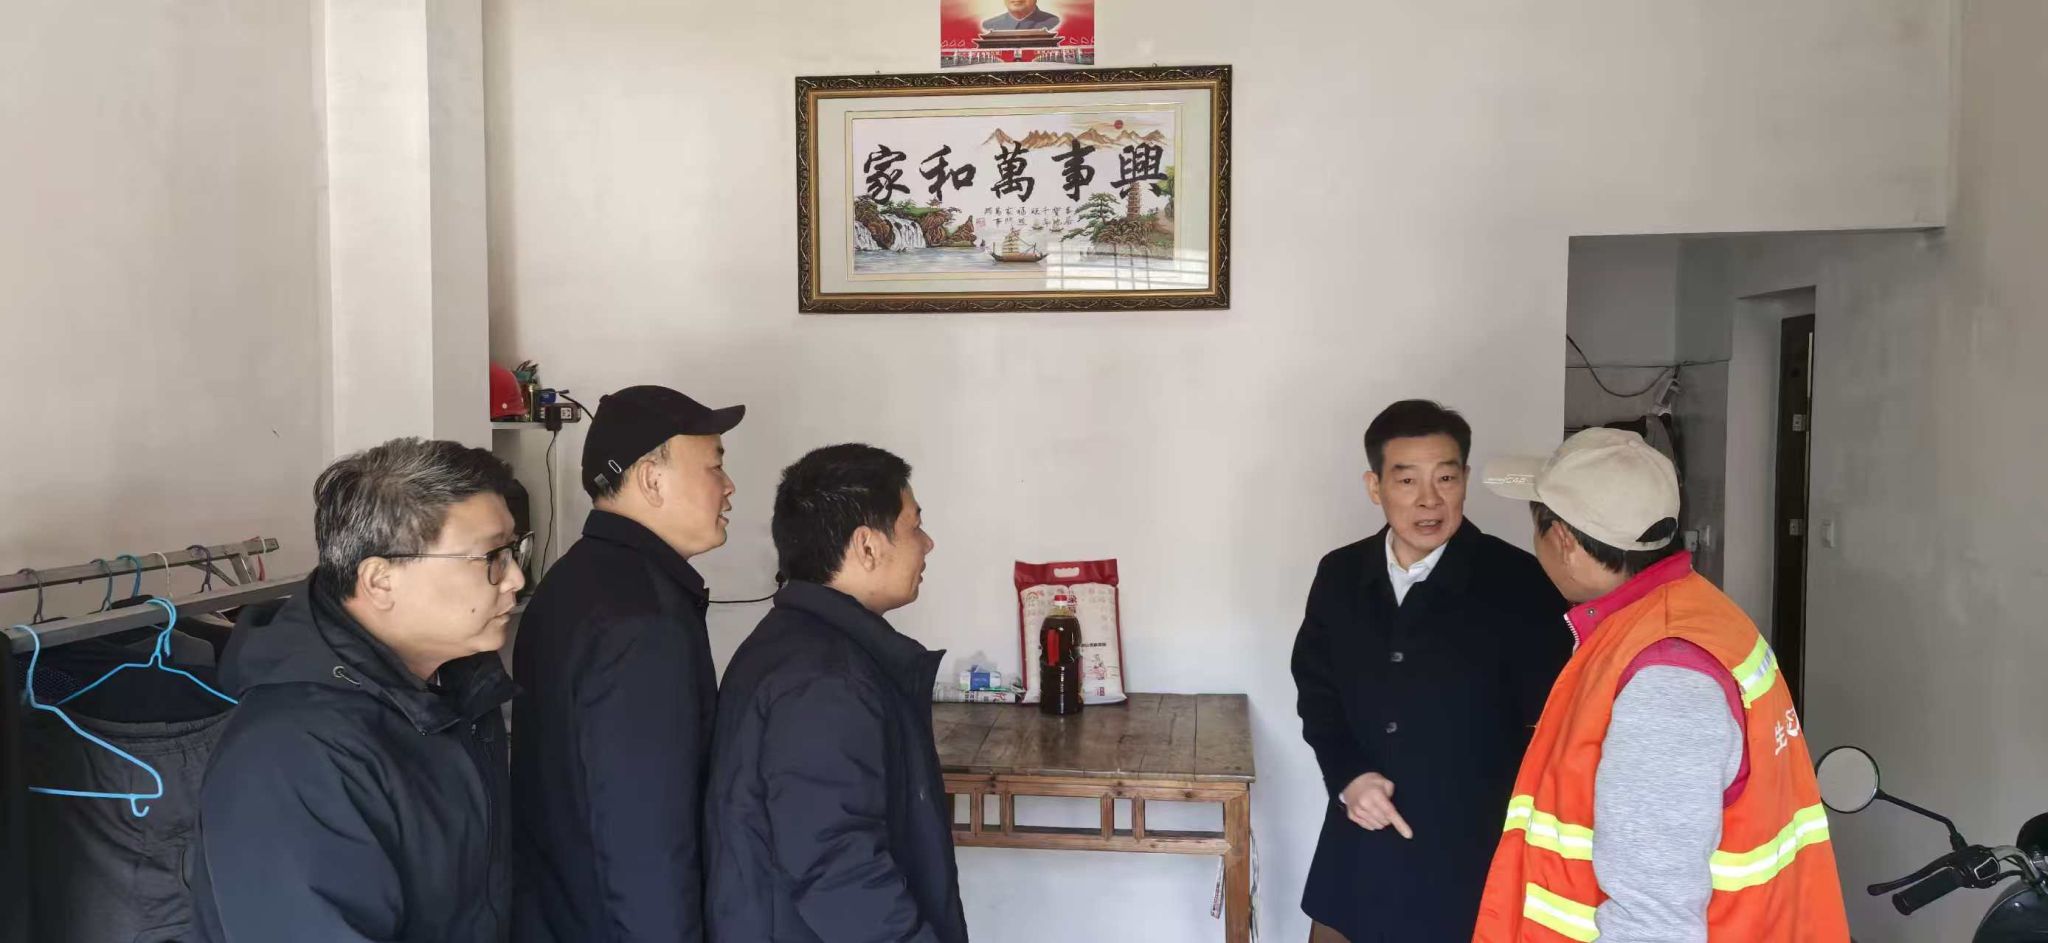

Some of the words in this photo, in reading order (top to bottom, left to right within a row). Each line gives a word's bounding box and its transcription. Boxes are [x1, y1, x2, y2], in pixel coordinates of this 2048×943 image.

[863, 138, 1168, 202] 家和萬事興
